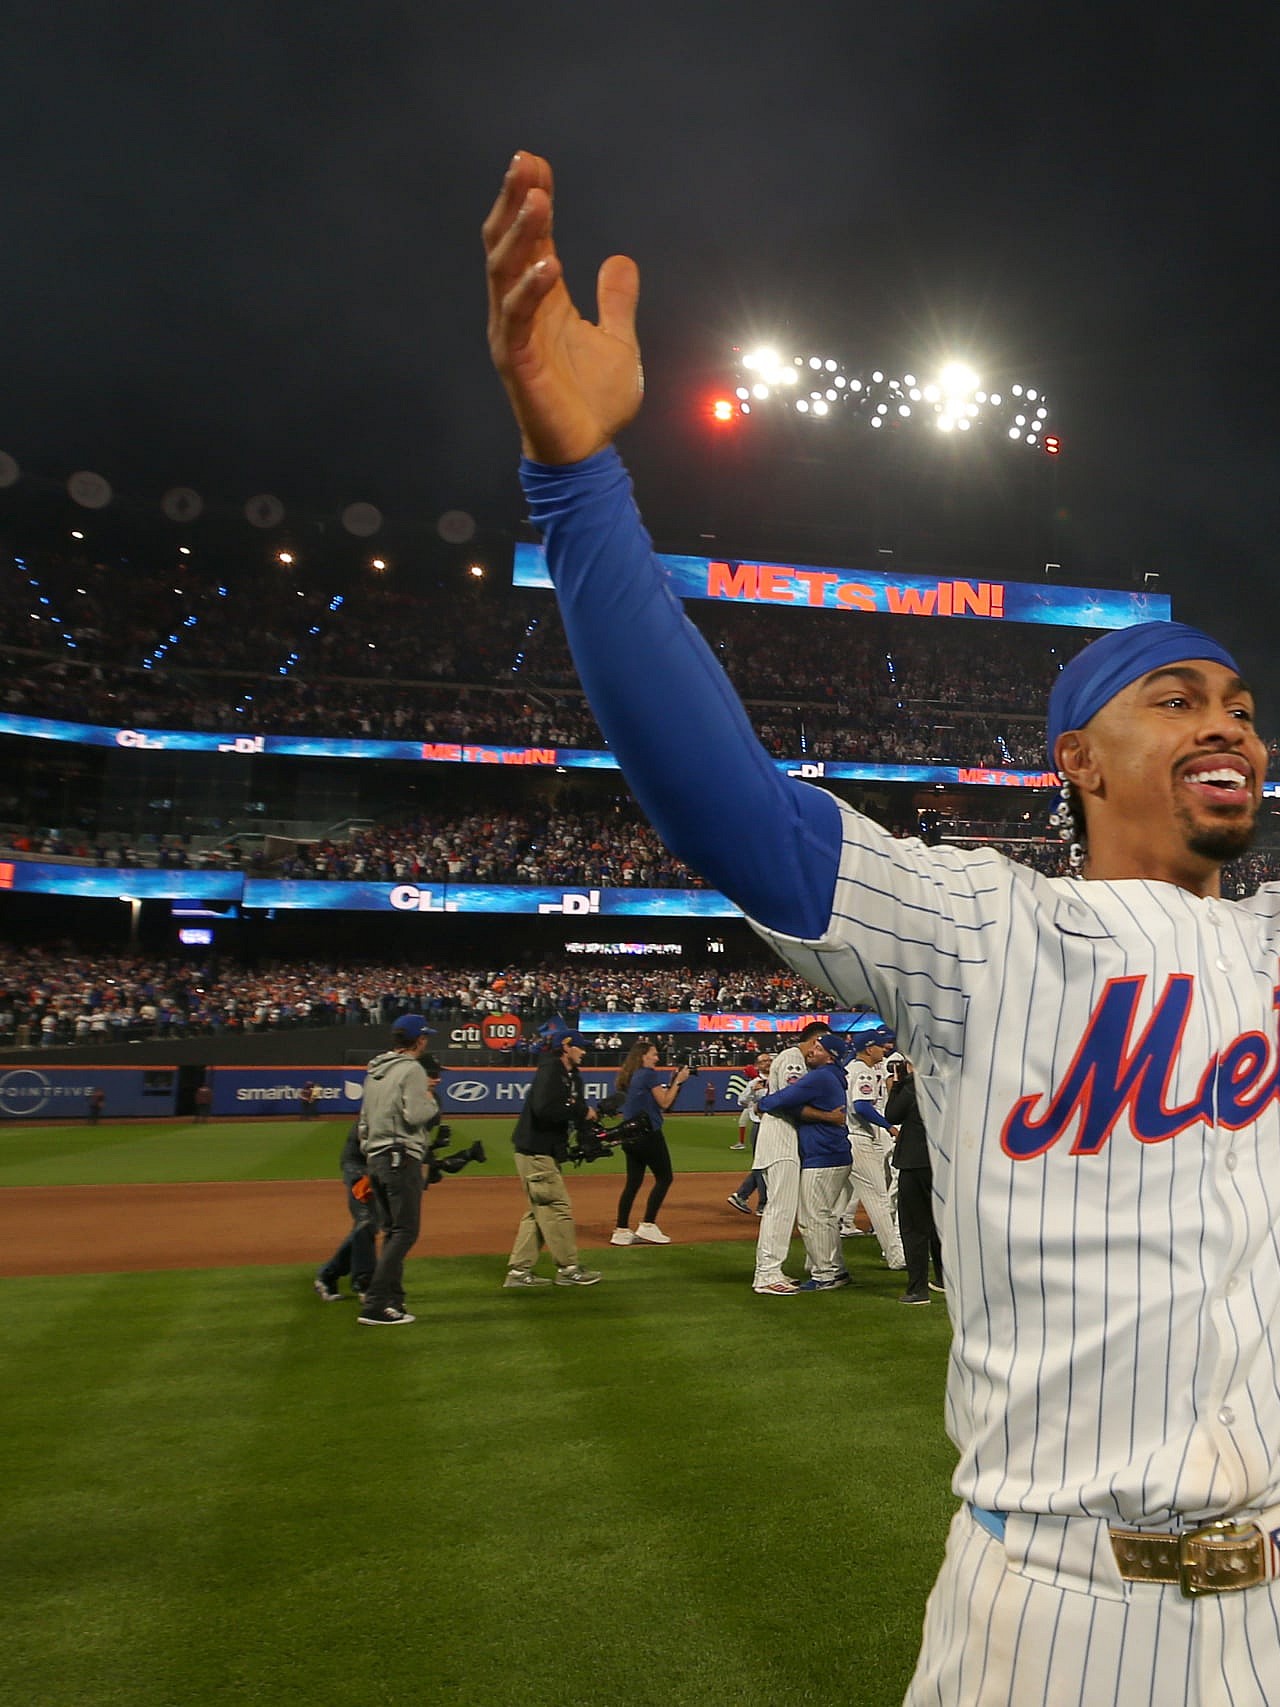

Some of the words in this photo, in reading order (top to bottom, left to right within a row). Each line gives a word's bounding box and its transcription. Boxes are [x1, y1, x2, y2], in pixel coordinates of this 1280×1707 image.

[886, 581, 1004, 618] WIN!
[451, 1026, 480, 1042] citi
[488, 1024, 517, 1039] 109
[496, 1083, 608, 1100] HYAI
